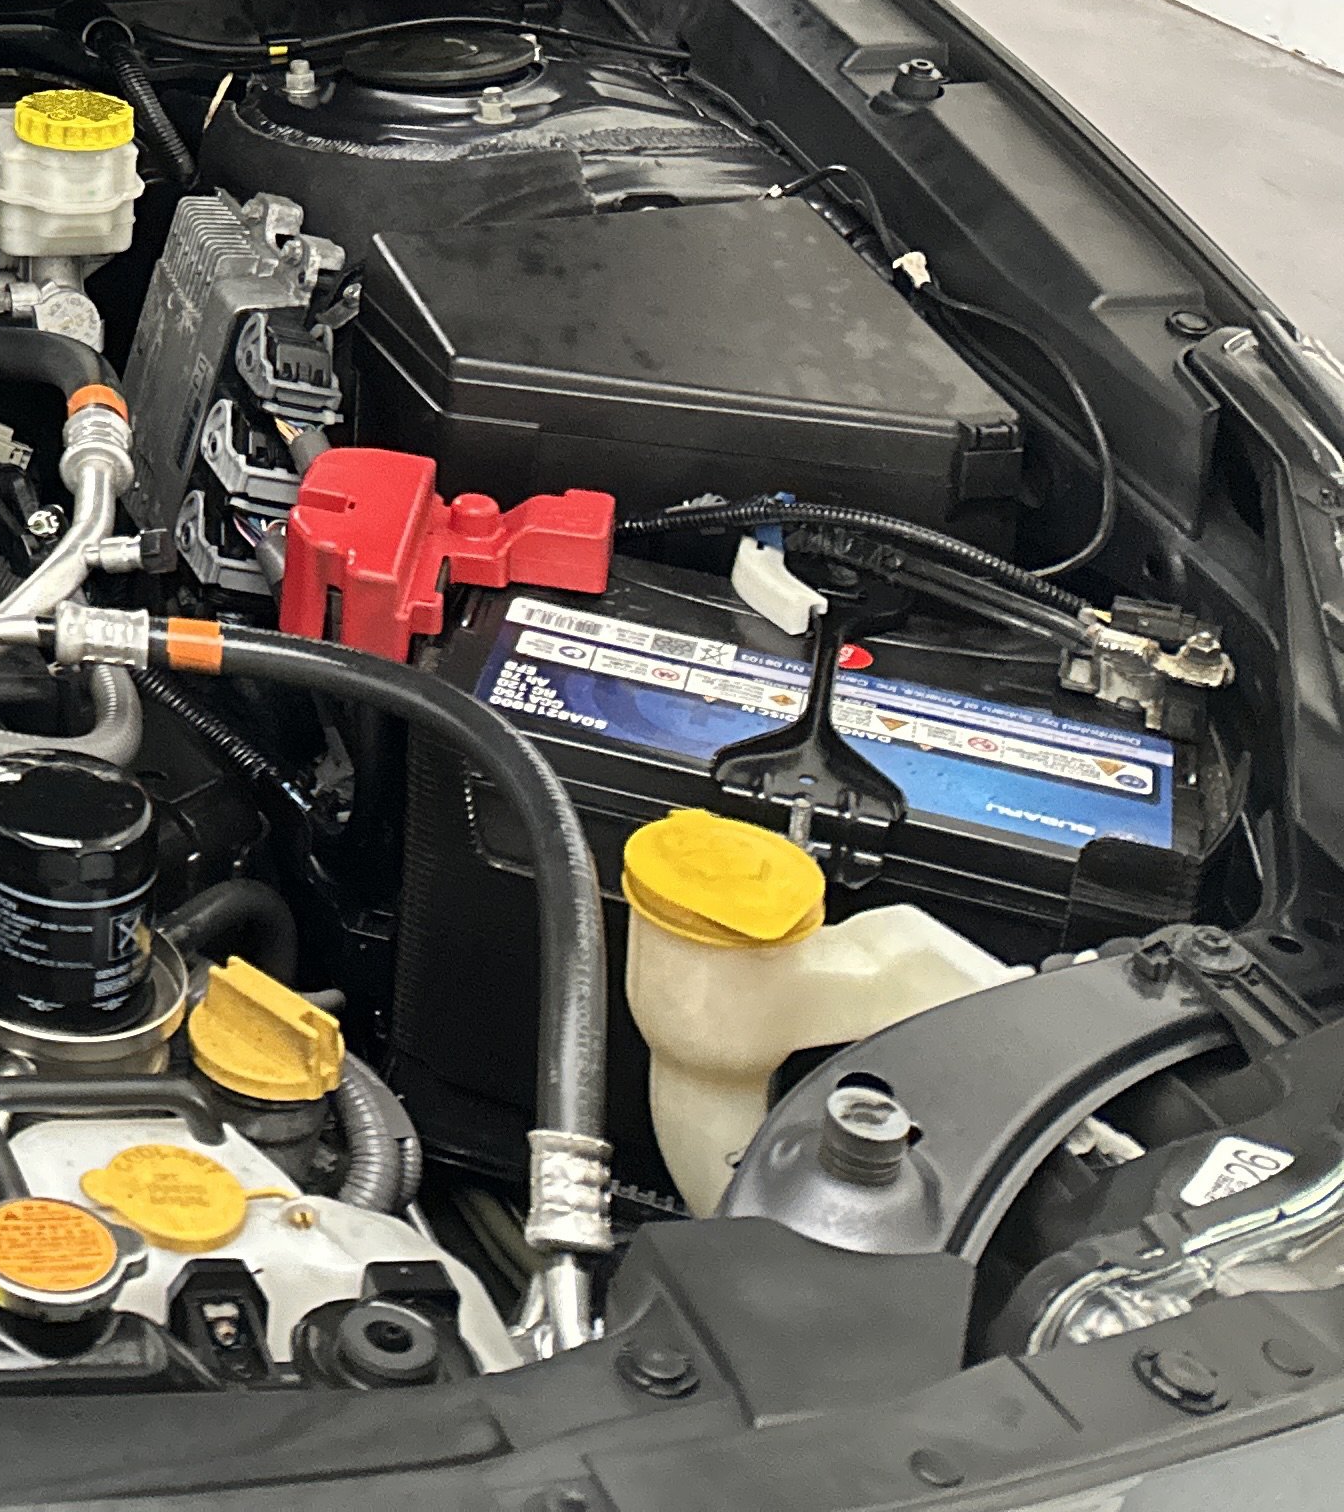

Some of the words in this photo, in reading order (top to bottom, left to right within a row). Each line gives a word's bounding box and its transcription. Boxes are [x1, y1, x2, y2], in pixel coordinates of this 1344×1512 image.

[504, 661, 538, 679] EFB
[497, 677, 527, 694] 120
[532, 684, 558, 702] RC
[529, 693, 565, 713] CCA
[982, 704, 1034, 723] Subaru
[833, 725, 892, 744] DANG
[1062, 721, 1142, 747] Distributed
[986, 801, 1096, 837] SUBARU
